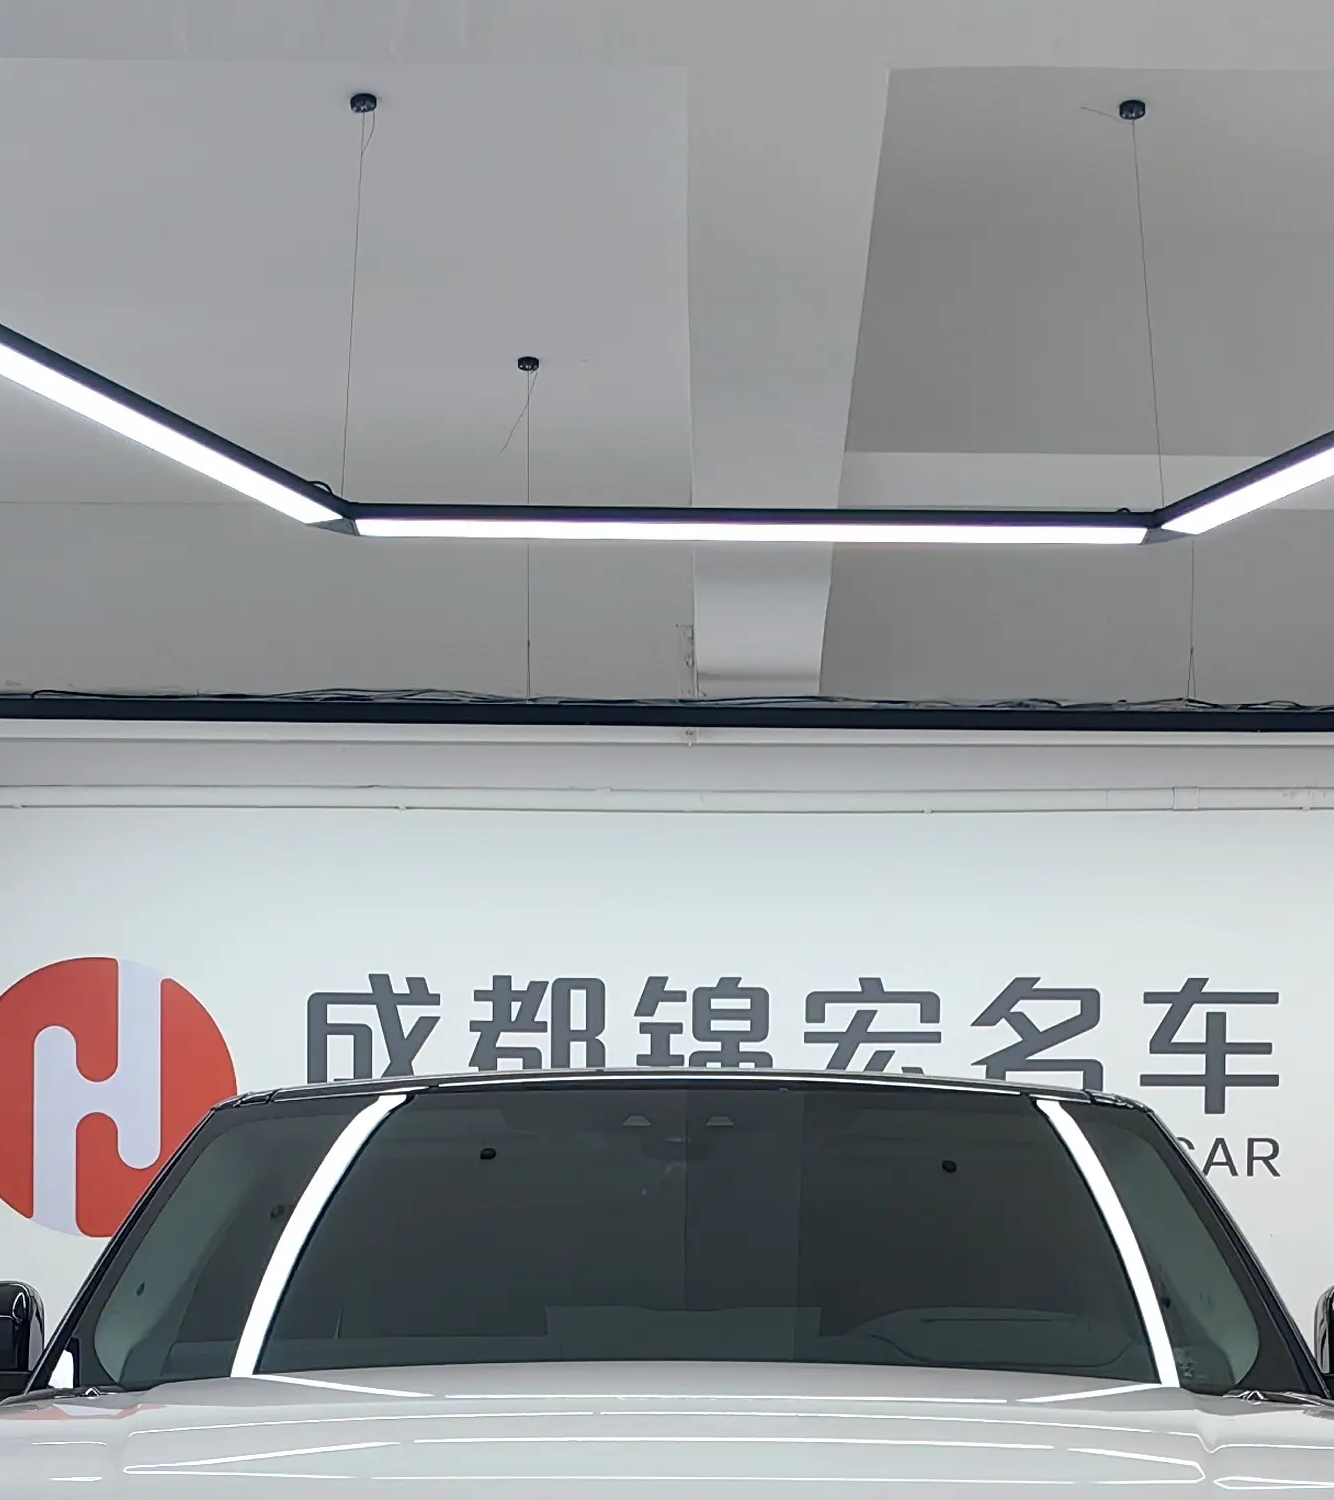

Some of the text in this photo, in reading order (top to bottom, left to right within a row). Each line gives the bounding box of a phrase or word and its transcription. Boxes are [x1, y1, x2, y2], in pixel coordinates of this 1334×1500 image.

[307, 973, 1279, 1114] 成都锦宏名车
